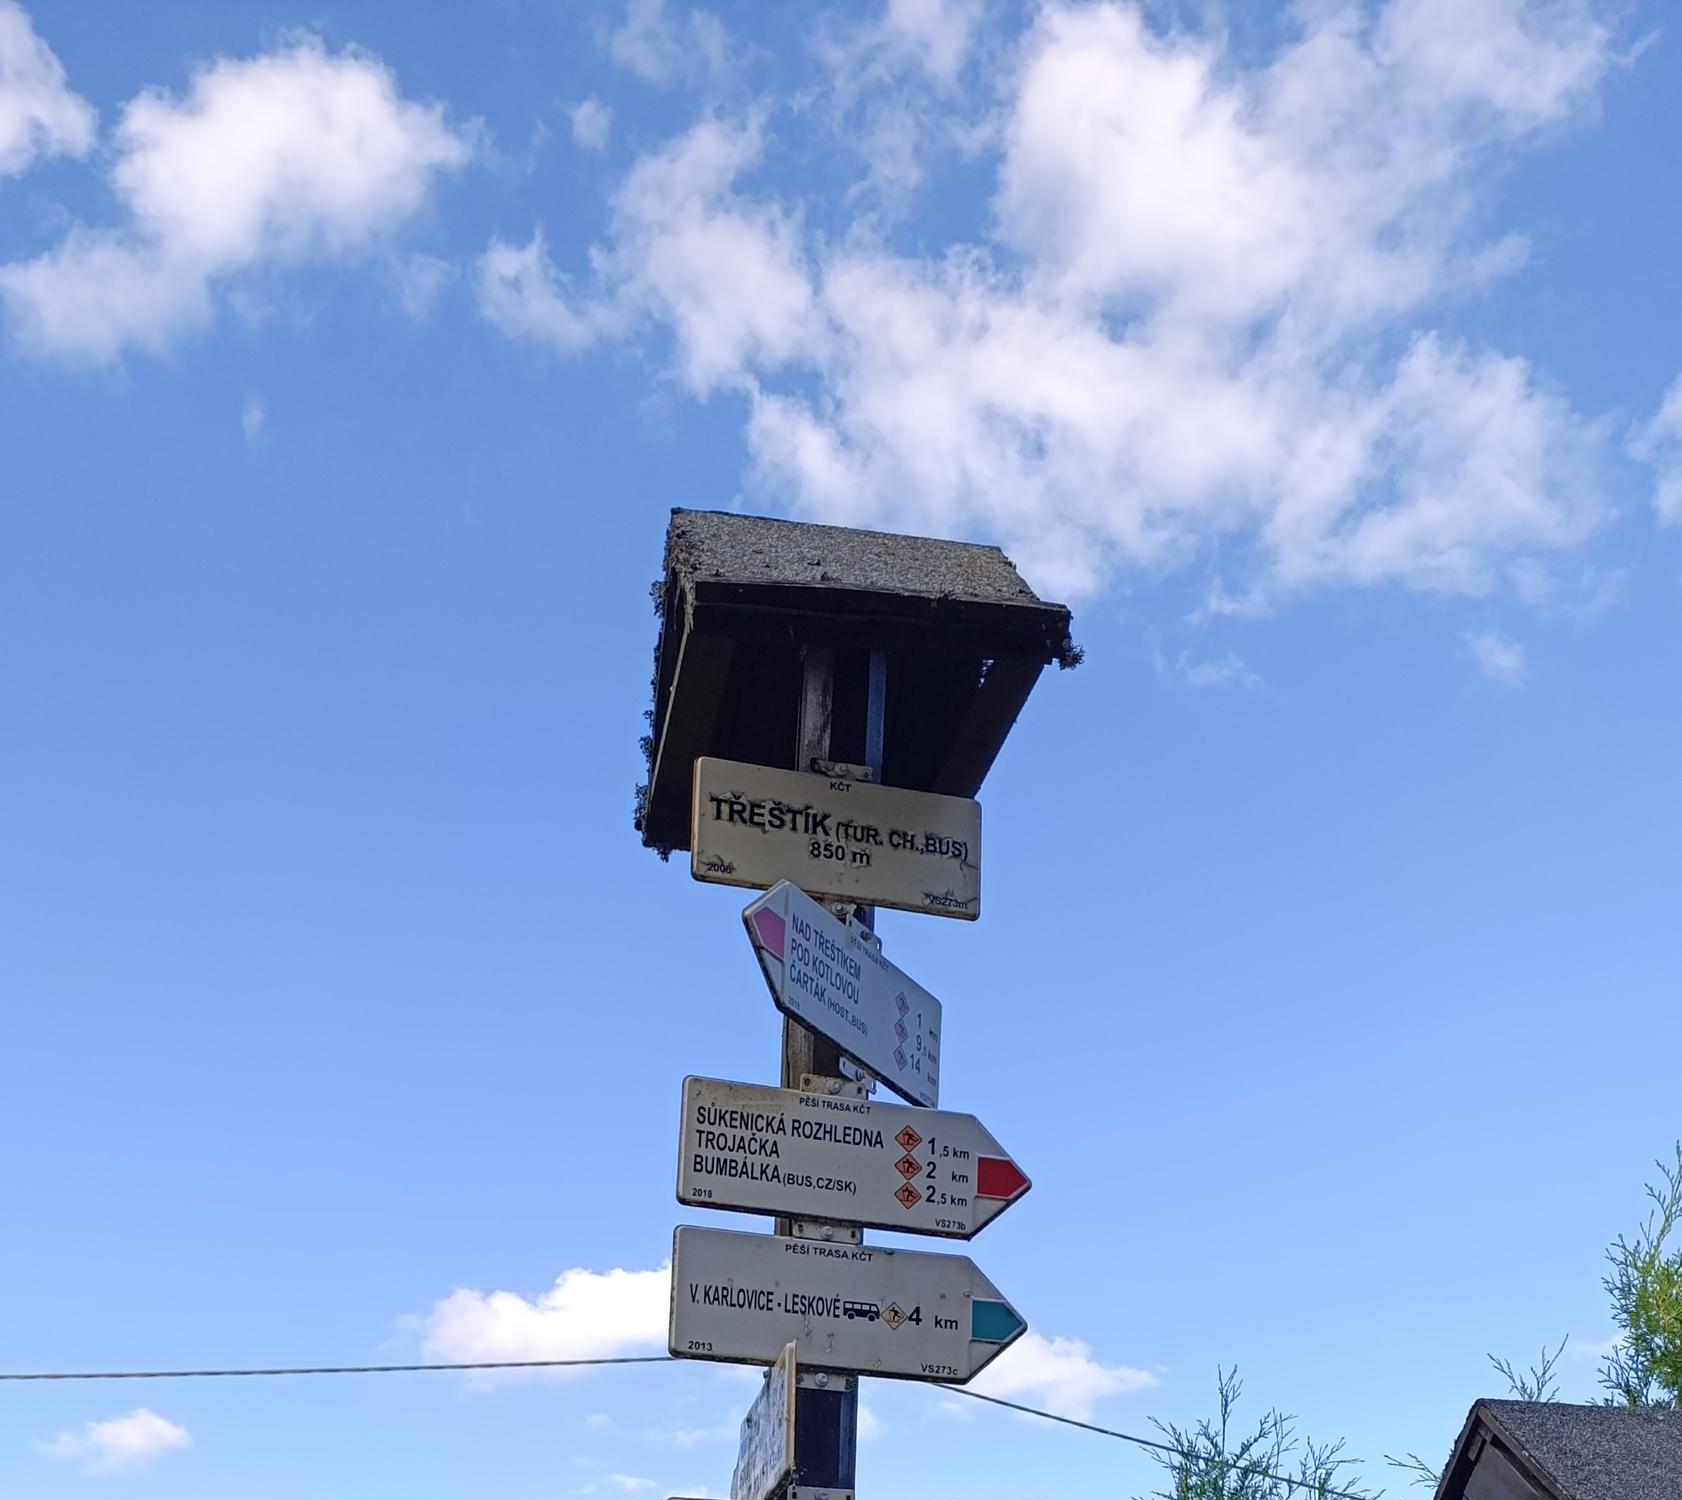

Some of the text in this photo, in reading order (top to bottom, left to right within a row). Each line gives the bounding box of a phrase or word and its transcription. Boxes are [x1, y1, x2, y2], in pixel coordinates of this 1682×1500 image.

[830, 781, 851, 792] KČT
[711, 794, 832, 837] TŘEŠTÍK
[835, 821, 883, 846] (TUR.
[810, 841, 871, 865] 850 m
[791, 938, 810, 966] POD
[812, 953, 860, 1004] KOTLOVOU
[792, 914, 811, 942] NAD
[813, 930, 861, 983] TŘEŠTÍKEM
[917, 1013, 921, 1029] 1
[789, 960, 826, 1006] ČARTÁK
[910, 1053, 920, 1074] 14
[799, 1096, 870, 1115] PĚŠÍ TRASA KČT
[696, 1102, 786, 1136] SŮKENICKÁ
[791, 1119, 884, 1149] ROZHLEDNA
[953, 1146, 969, 1160] km
[696, 1129, 968, 1184] TROJAČKA 2 km
[692, 1188, 713, 1199] 2018
[950, 1194, 968, 1208] km
[935, 1218, 966, 1231] VS273b
[785, 1243, 873, 1262] PĚŠÍ TRASA KČT
[689, 1283, 700, 1304] V.
[703, 1285, 774, 1312] KARLOVICE
[784, 1293, 841, 1319] LESKOVÉ
[908, 1306, 922, 1326] 4
[934, 1315, 958, 1331] km
[688, 1341, 713, 1352] 2013
[921, 1364, 958, 1376] VS273c
